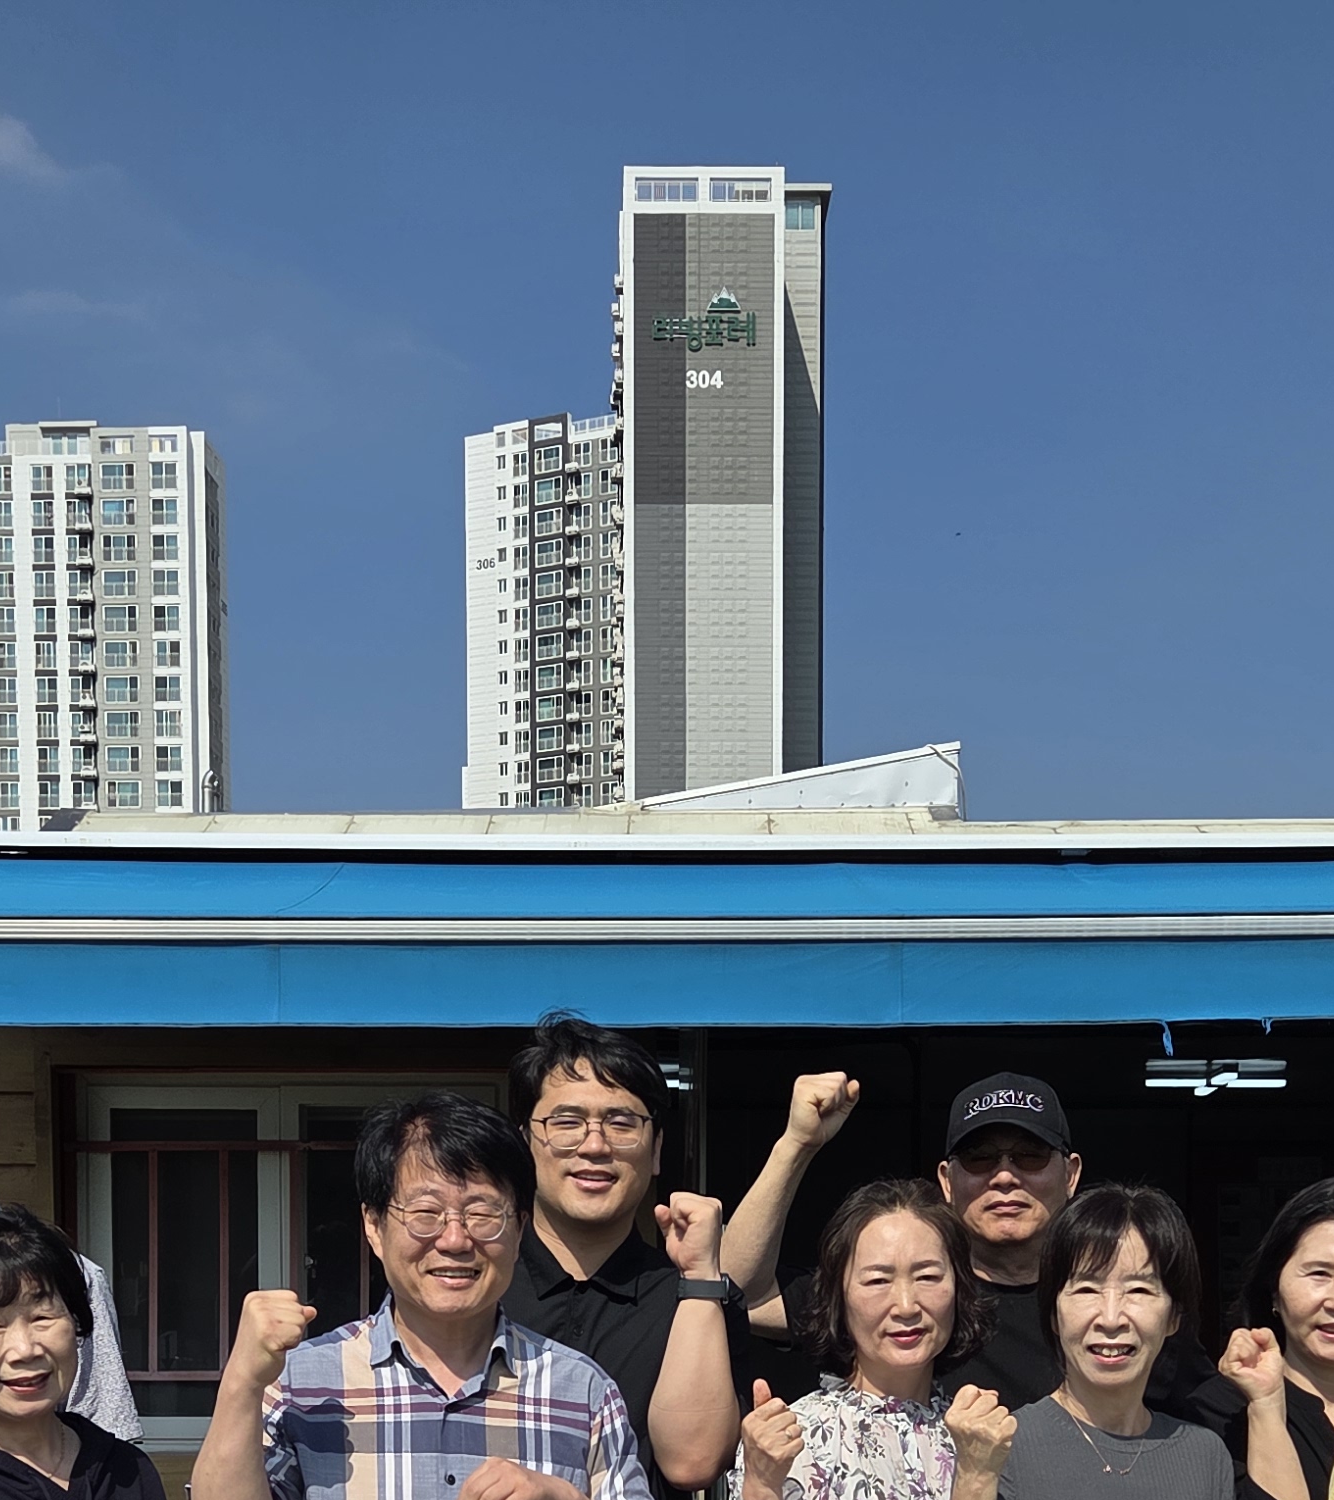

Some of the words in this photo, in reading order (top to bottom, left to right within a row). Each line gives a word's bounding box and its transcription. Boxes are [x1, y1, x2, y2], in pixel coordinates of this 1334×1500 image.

[685, 370, 724, 389] 304
[476, 558, 496, 571] 306
[963, 1088, 1045, 1120] ROKMC
